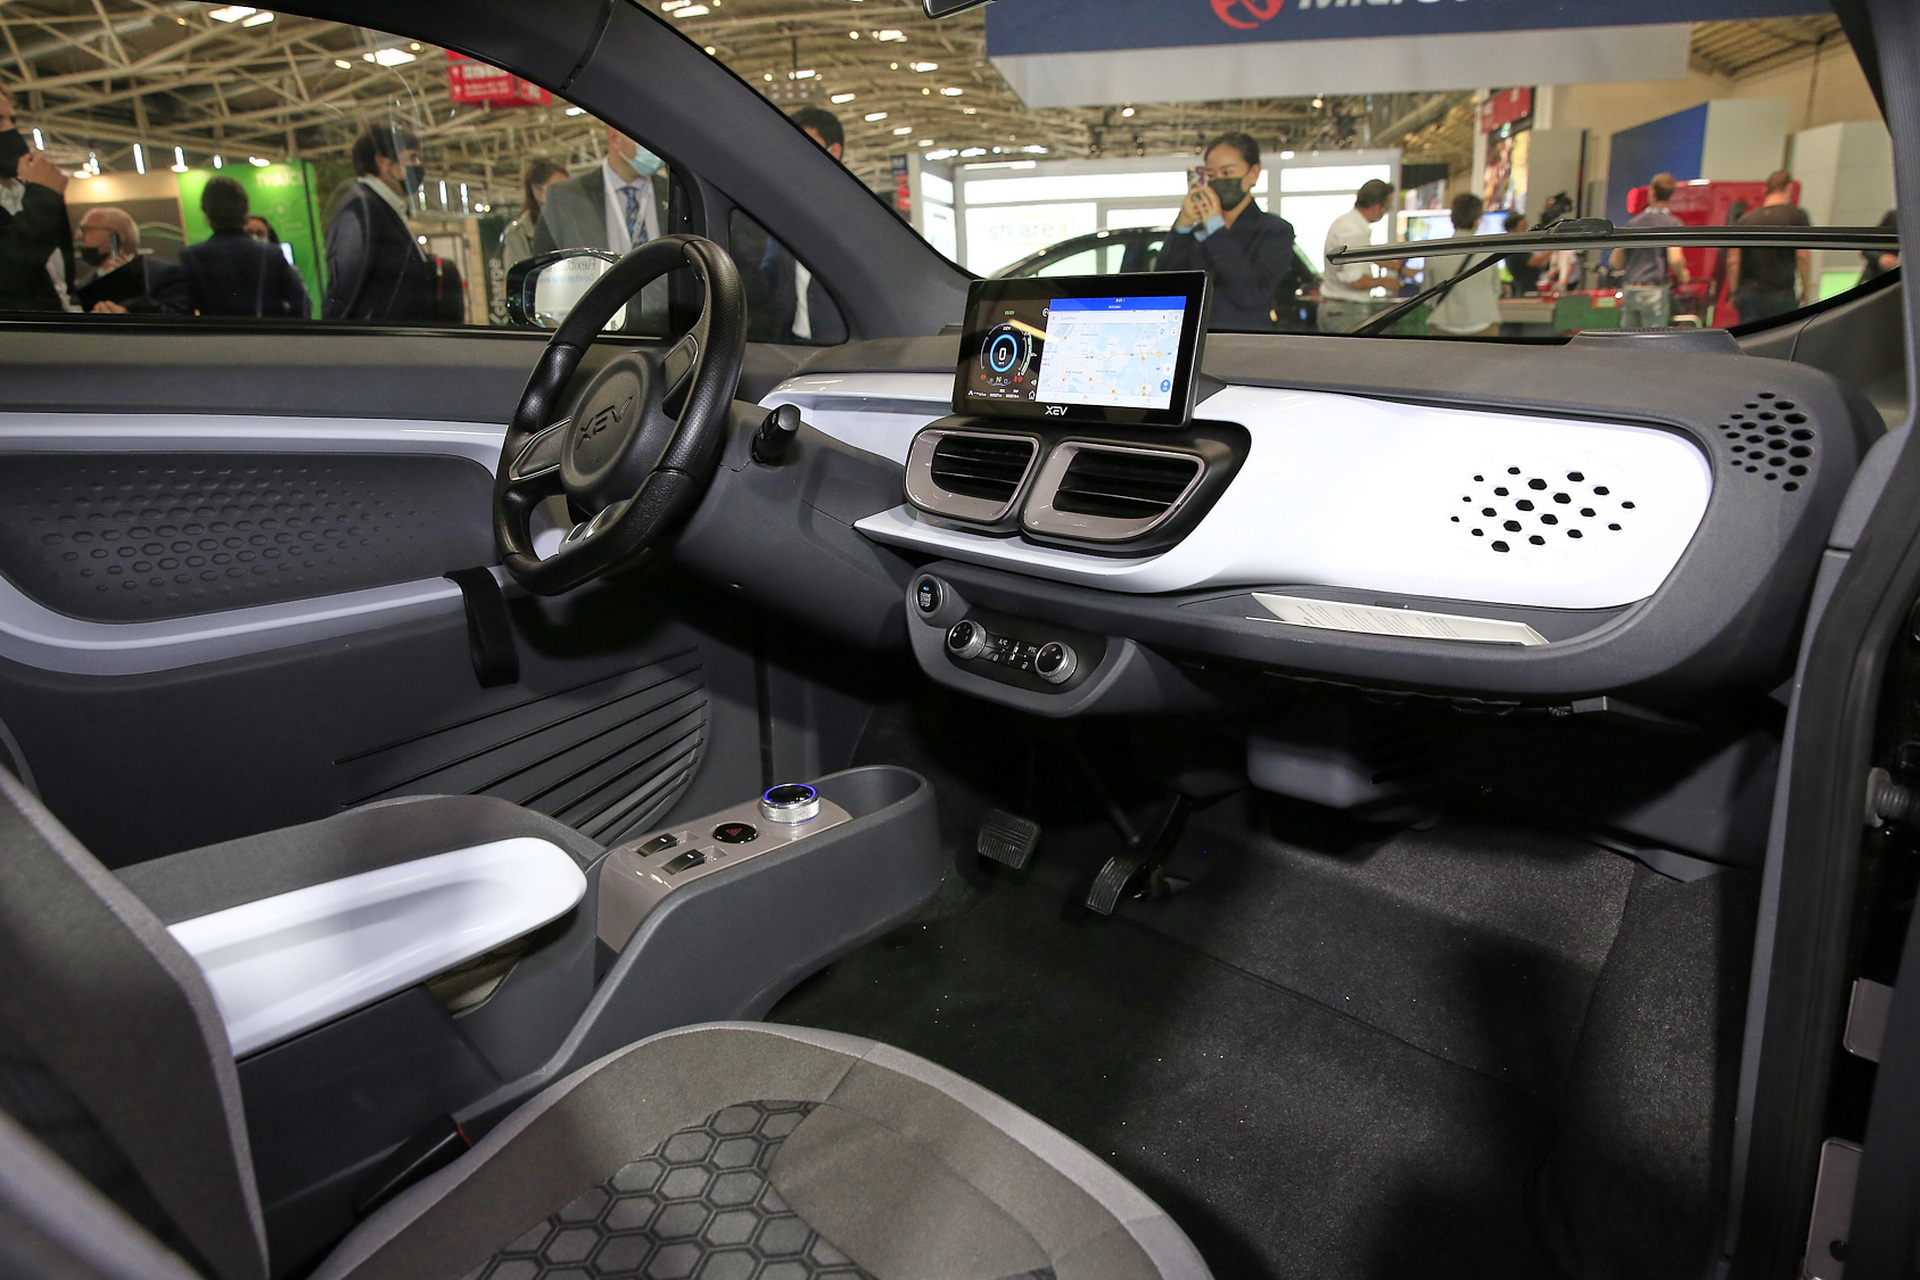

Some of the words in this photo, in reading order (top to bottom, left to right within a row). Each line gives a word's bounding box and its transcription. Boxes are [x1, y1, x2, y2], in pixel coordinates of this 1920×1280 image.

[999, 347, 1007, 361] 0
[1045, 405, 1068, 416] XEV
[577, 396, 633, 450] XEV
